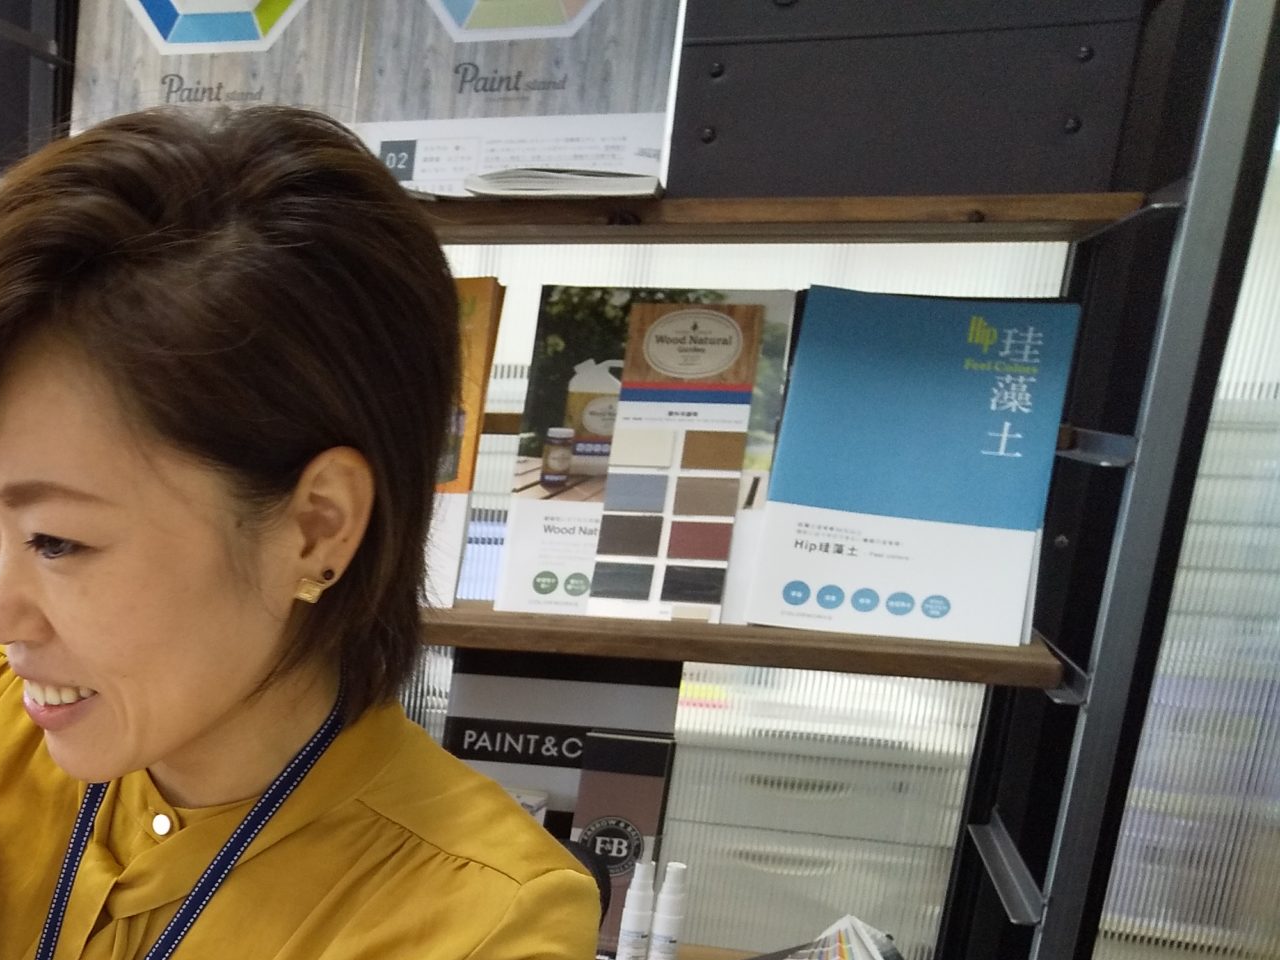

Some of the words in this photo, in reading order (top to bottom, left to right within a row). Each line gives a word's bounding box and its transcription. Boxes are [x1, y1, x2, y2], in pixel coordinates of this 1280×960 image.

[161, 73, 224, 103] Paint
[454, 61, 522, 94] Paint
[386, 151, 409, 170] 02
[655, 334, 686, 345] Wood
[689, 335, 733, 346] Natural
[980, 326, 1044, 458] 珪藻土
[543, 523, 576, 535] Wood
